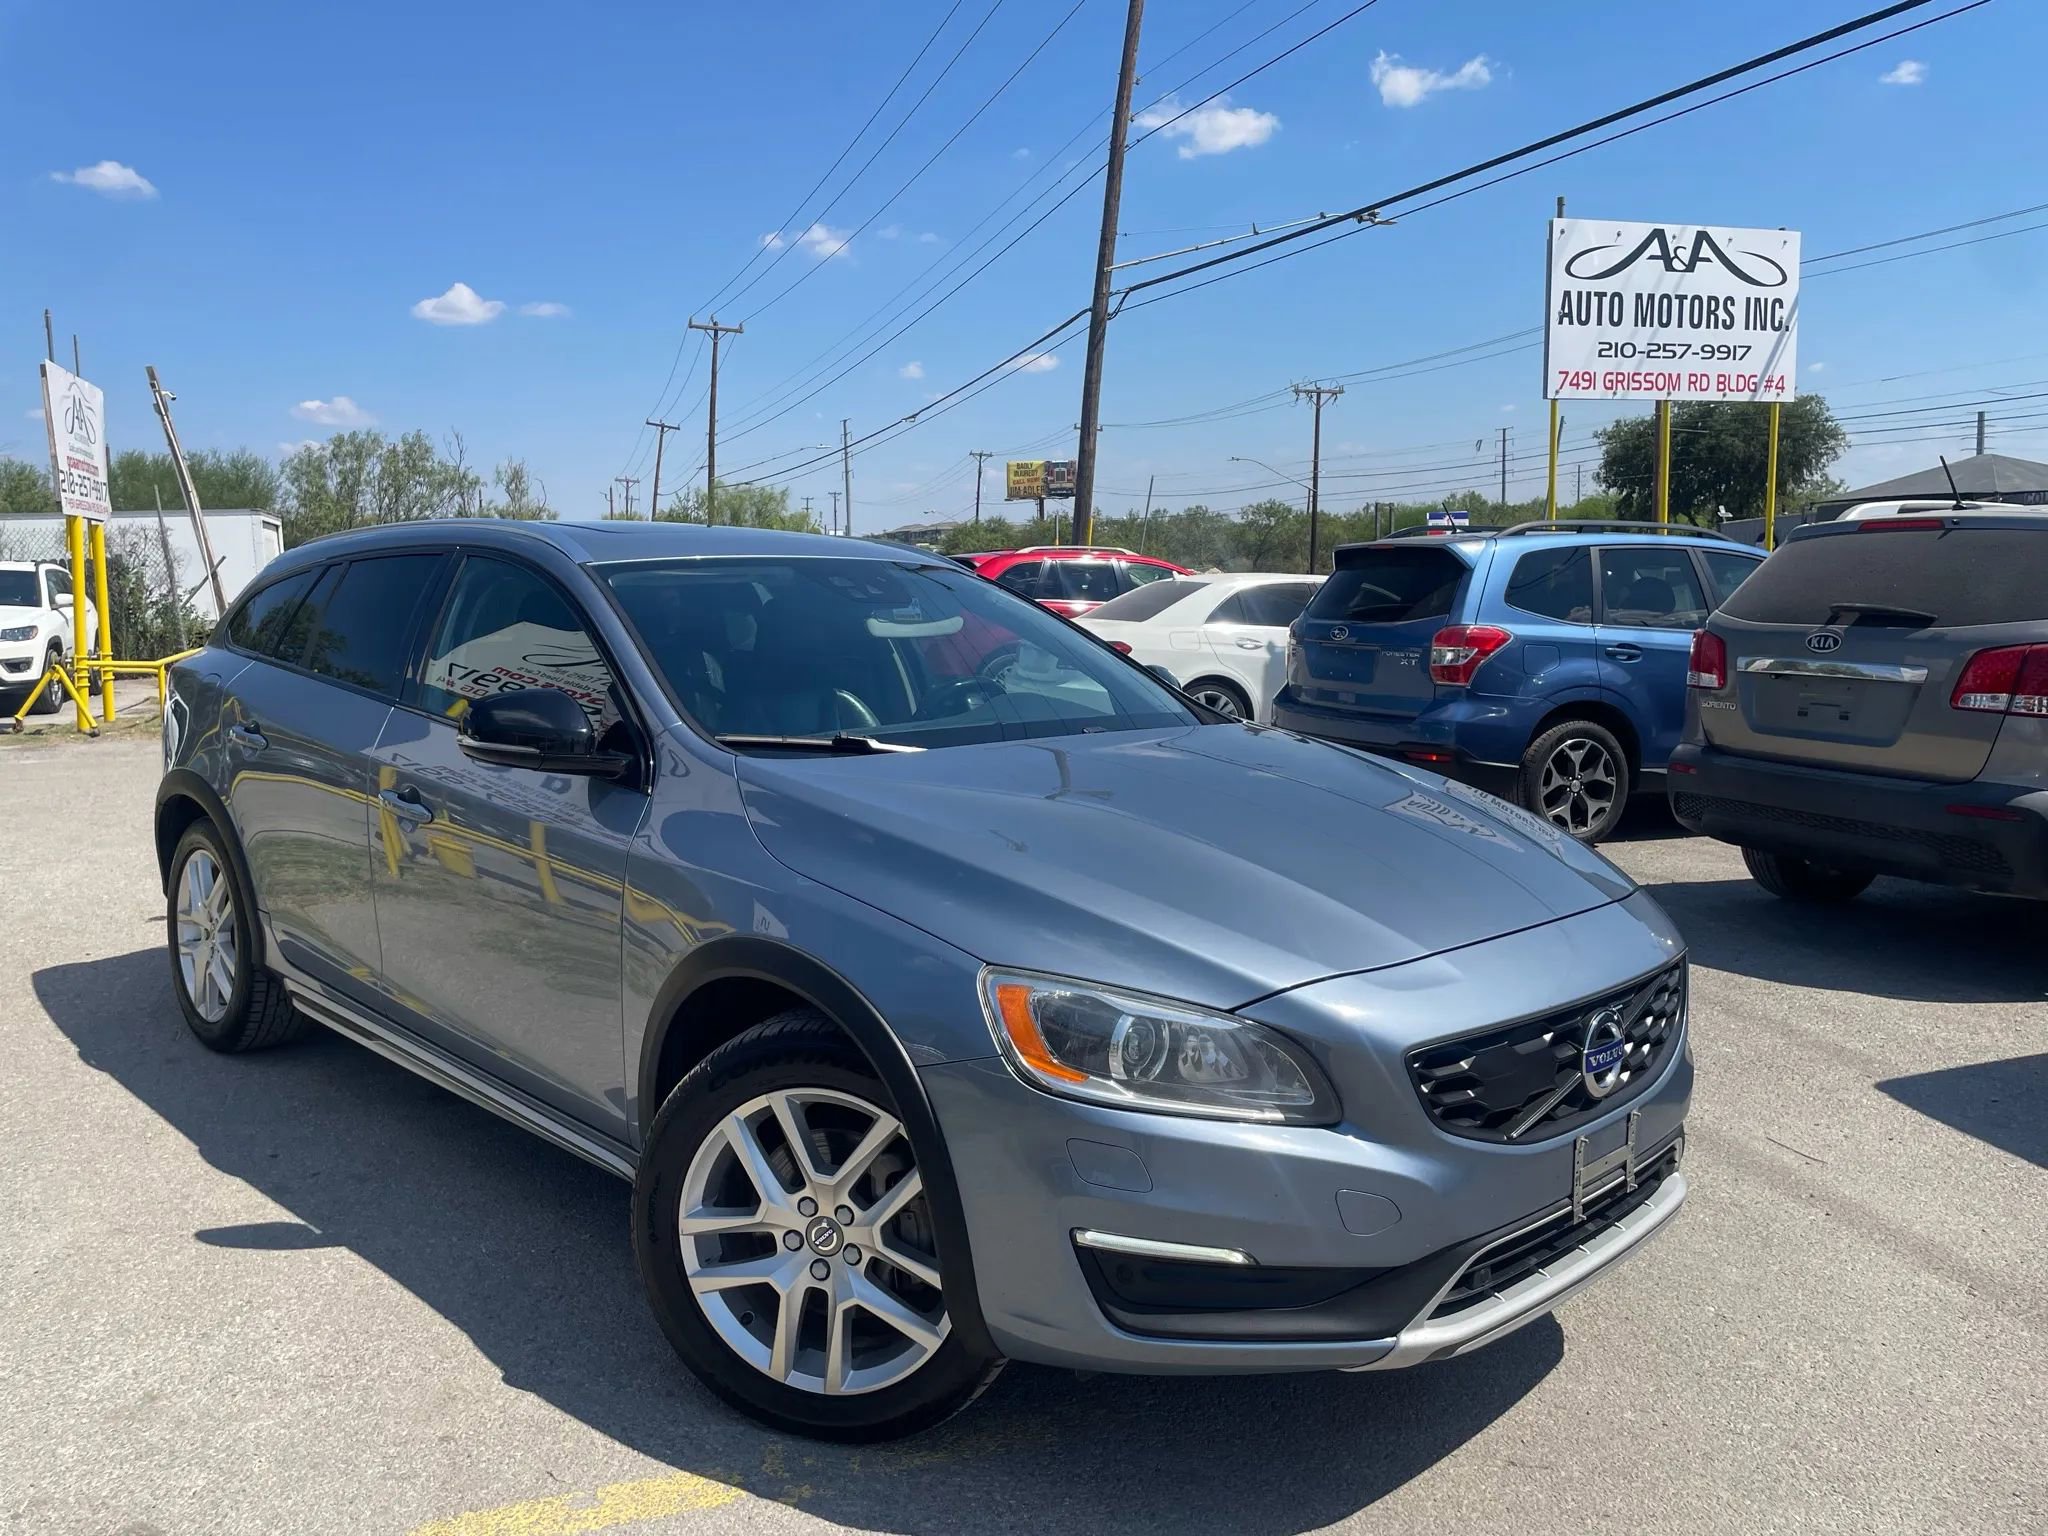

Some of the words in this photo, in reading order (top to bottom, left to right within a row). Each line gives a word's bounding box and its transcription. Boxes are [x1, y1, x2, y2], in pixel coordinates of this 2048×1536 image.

[1565, 228, 1787, 287] A&A
[1558, 290, 1623, 328] AUTO
[1634, 293, 1735, 331] MOTORS
[1744, 297, 1790, 332] INC.
[1597, 342, 1752, 361] 210-257-9917
[1558, 370, 1597, 391] 7491
[1603, 371, 1681, 392] GRISSOM
[1688, 373, 1710, 392] RD
[1716, 374, 1758, 393] BLDG
[1763, 375, 1785, 393] #4
[1811, 637, 1834, 648] KIA
[1701, 700, 1737, 710] SORENTO
[1589, 1044, 1623, 1067] VOLVO
[814, 1229, 833, 1245] VOLVO
